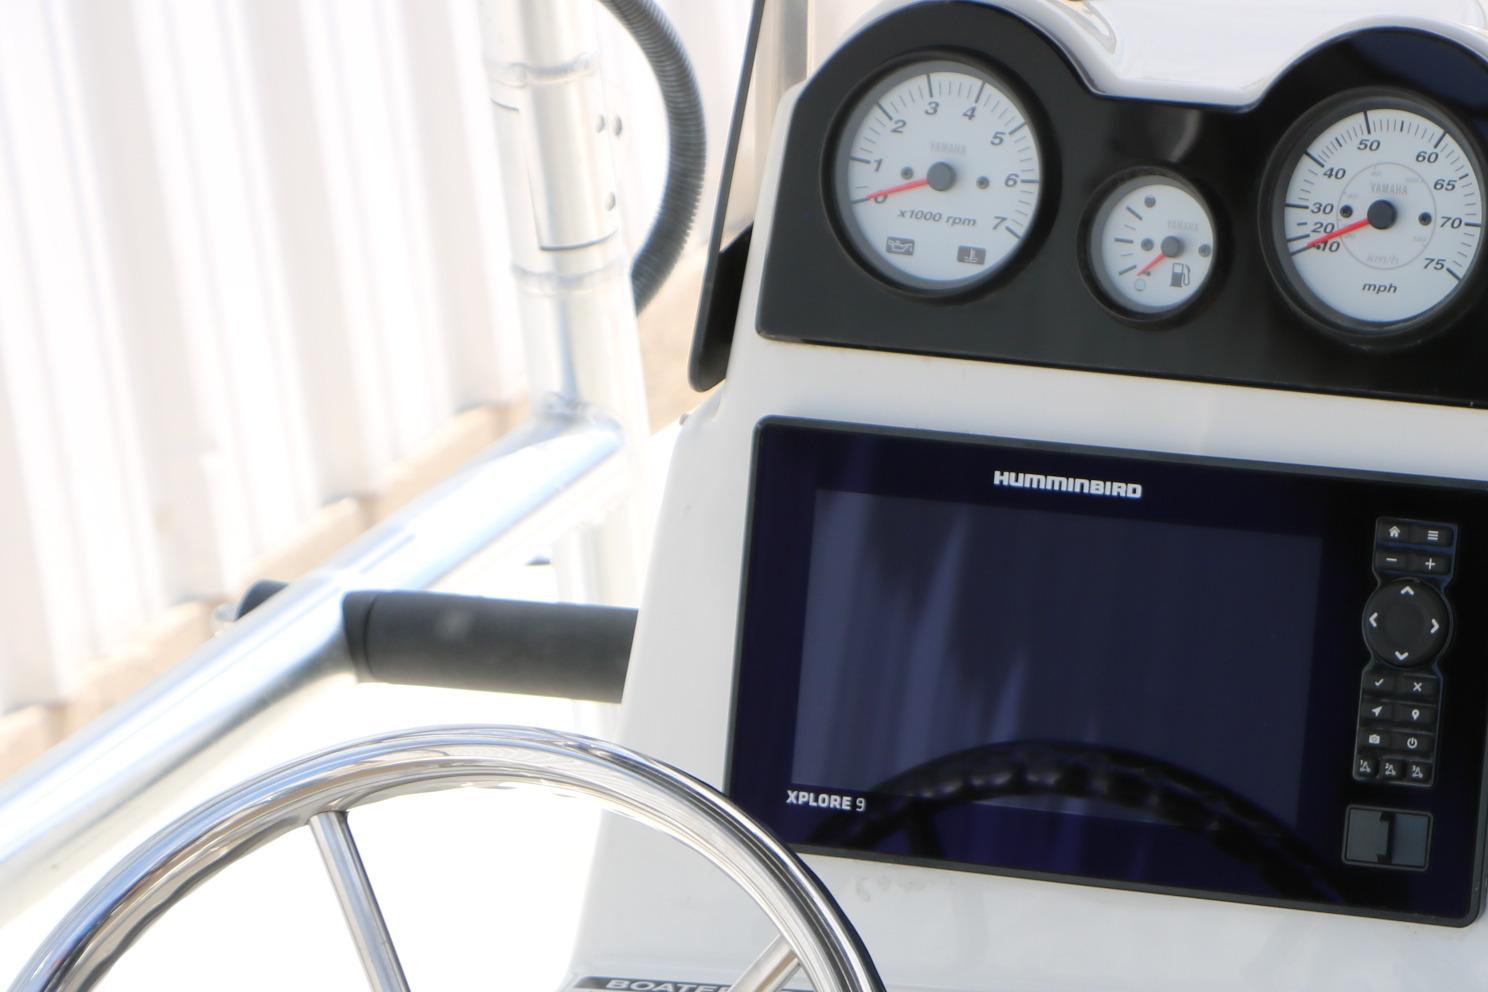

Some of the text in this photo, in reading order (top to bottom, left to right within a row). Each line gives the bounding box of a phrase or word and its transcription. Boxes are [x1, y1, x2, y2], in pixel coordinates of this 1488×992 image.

[925, 101, 939, 116] 3
[962, 106, 977, 121] 4
[891, 120, 906, 134] 2
[990, 131, 1006, 146] 5
[1357, 139, 1381, 152] 50
[1416, 151, 1439, 164] 60
[872, 158, 883, 172] 1
[1004, 173, 1019, 188] 6
[1323, 167, 1346, 180] 40
[1369, 181, 1408, 196] YAMAHA
[1433, 179, 1457, 192] 65
[1311, 201, 1334, 215] 30
[897, 209, 977, 228] x1000 rpm
[992, 216, 1007, 230] 7
[1440, 216, 1463, 229] 70
[1311, 222, 1335, 234] 20
[1423, 258, 1446, 271] 75
[1362, 281, 1398, 294] mph
[993, 470, 1143, 498] HUMMINBIRD
[785, 789, 866, 812] XPLORE 9
